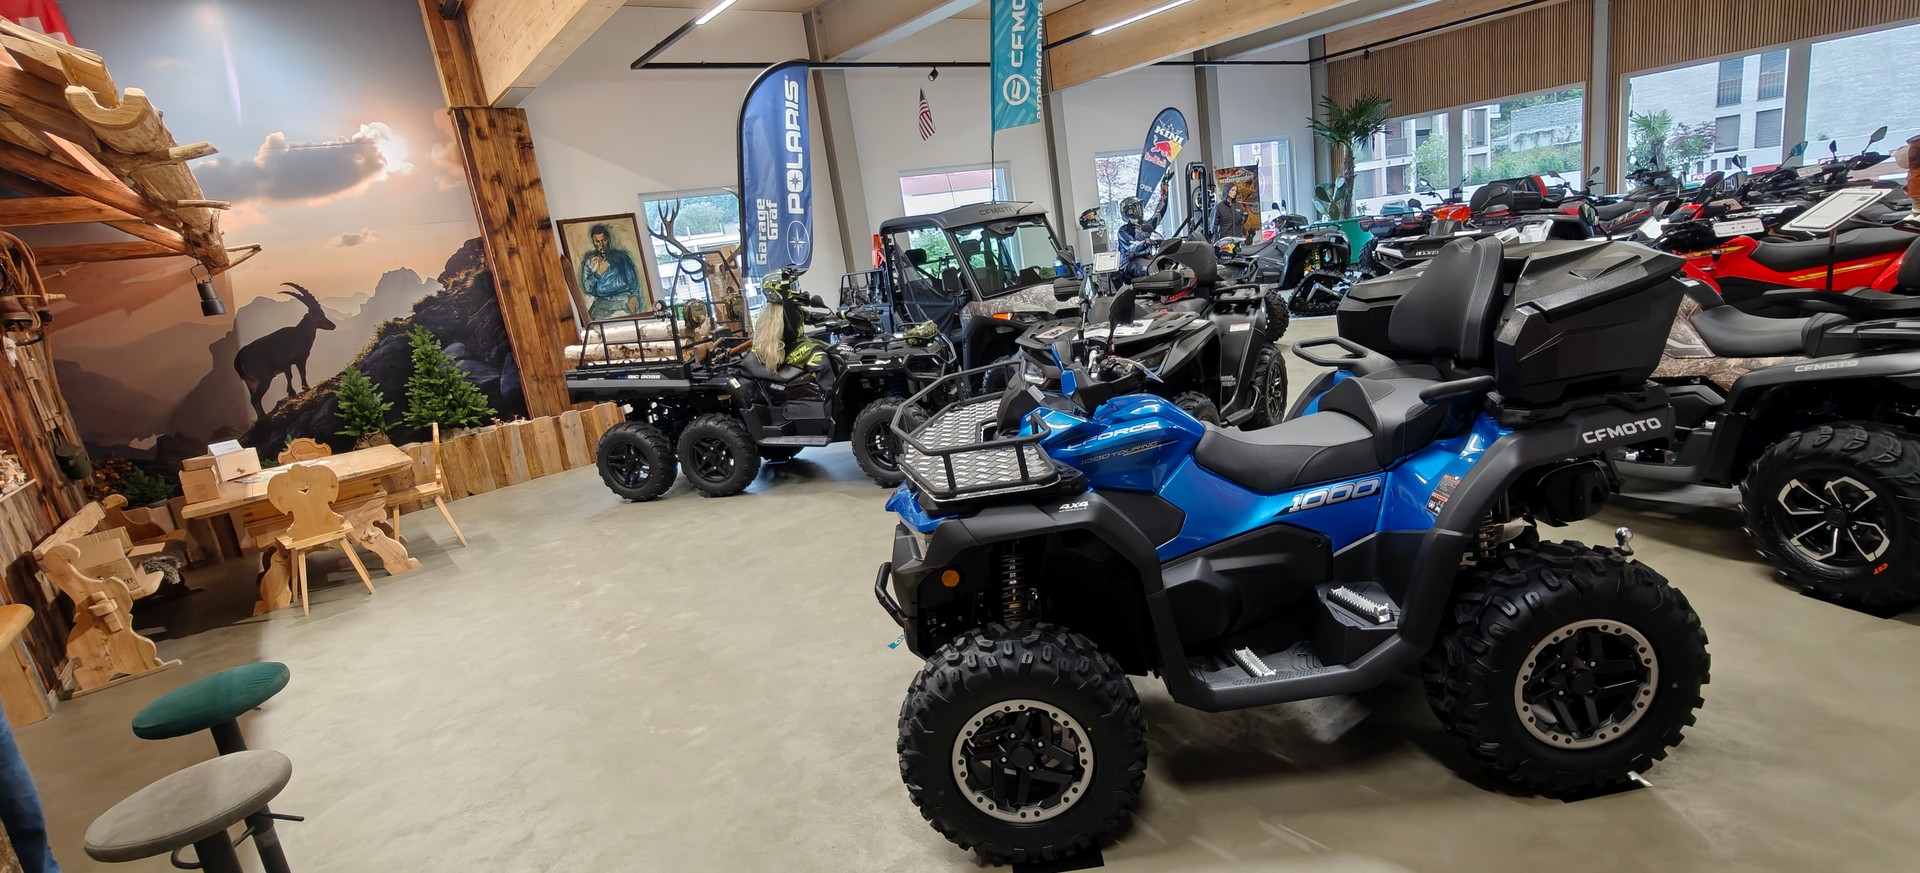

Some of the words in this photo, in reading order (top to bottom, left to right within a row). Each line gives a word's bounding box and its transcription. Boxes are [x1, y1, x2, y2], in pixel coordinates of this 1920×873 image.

[784, 79, 805, 215] POLARIS
[1154, 125, 1185, 146] KINI
[756, 198, 768, 266] Garage
[767, 199, 779, 241] Graf
[1794, 359, 1860, 373] CFMOTO
[1582, 417, 1662, 444] CFMOTO
[1288, 477, 1381, 513] 1000
